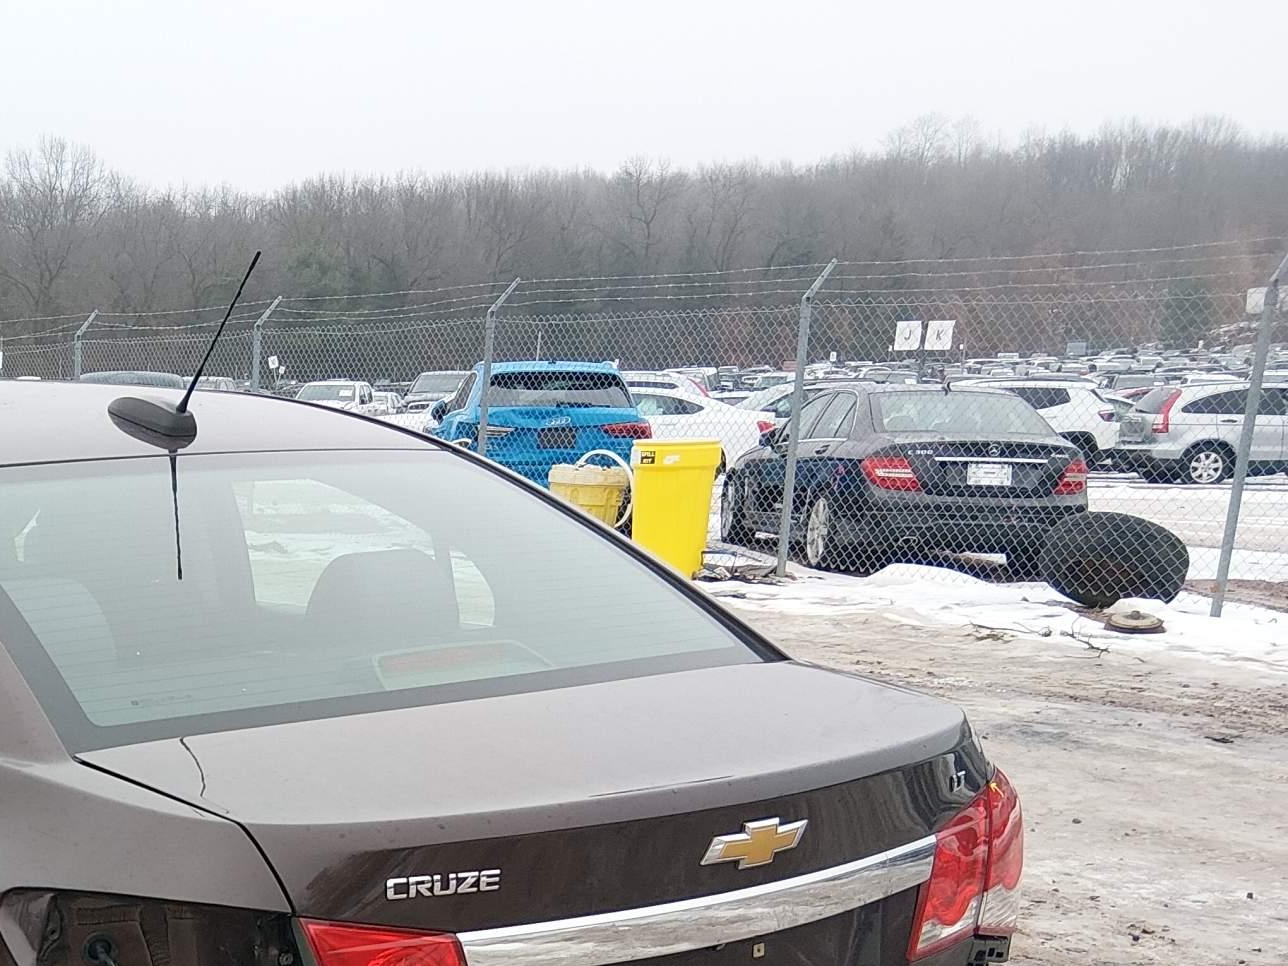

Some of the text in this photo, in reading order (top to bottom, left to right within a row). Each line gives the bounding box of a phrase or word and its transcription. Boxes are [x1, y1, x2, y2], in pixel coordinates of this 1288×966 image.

[903, 329, 912, 341] J
[935, 329, 945, 341] K
[386, 869, 501, 900] CRUZE
